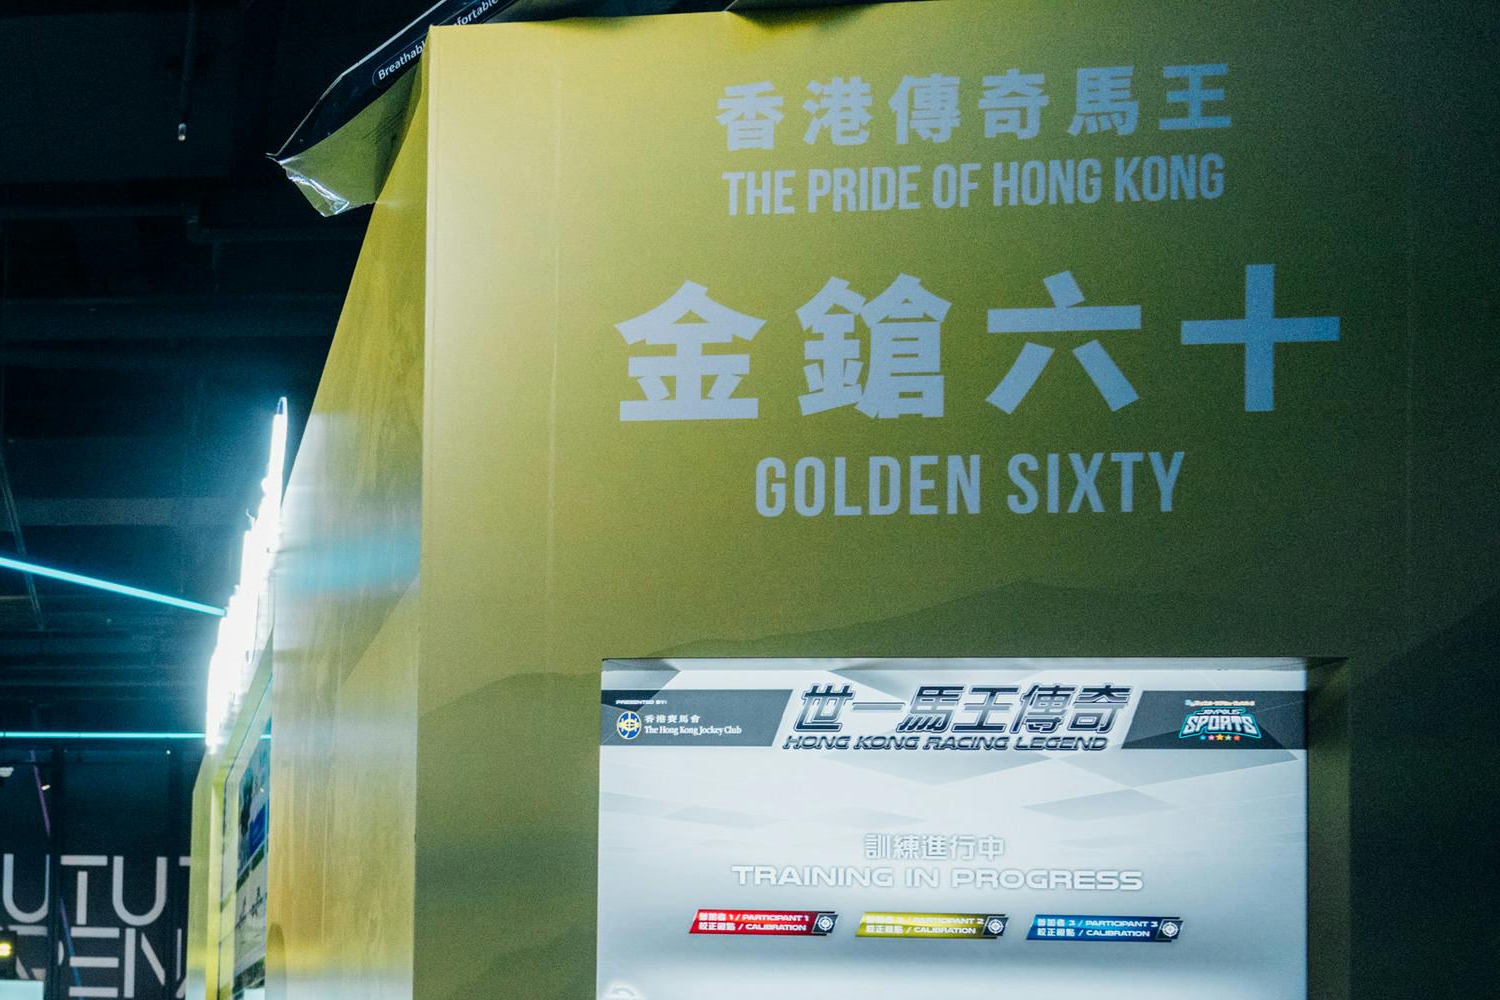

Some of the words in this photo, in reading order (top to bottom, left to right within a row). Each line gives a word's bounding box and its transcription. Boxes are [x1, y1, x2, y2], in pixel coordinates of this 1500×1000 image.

[716, 64, 1231, 151] 香港傳奇馬王
[722, 169, 796, 217] THE
[808, 165, 921, 213] PRIDE
[932, 162, 982, 209] OF
[992, 158, 1101, 206] HONG
[1115, 152, 1225, 202] KONG
[614, 264, 1341, 421] 金鎗六十
[755, 455, 981, 518] GOLDEN
[1007, 450, 1186, 514] SIXTY
[793, 683, 1133, 734] 世一馬王傳奇
[644, 725, 659, 734] The
[659, 725, 679, 735] Hong
[680, 725, 699, 735] Kong
[698, 725, 723, 736] Jockey
[724, 725, 742, 734] Club
[1182, 715, 1258, 735] SPORTS
[784, 735, 853, 750] HONG
[854, 735, 923, 750] KONG
[923, 735, 1013, 750] RACING
[1014, 735, 1109, 751] LEGEND
[864, 833, 1006, 861] 訓練進行中
[732, 865, 893, 887] TRAINING
[905, 867, 940, 888] IN
[951, 868, 1144, 891] PROGRESS
[742, 914, 803, 922] PARTICIPANT
[745, 923, 807, 931] CALIBRATION
[1086, 919, 1149, 928] PARTICIPANT
[914, 926, 977, 934] CALIBRATION
[1086, 929, 1150, 937] CALIBRATION
